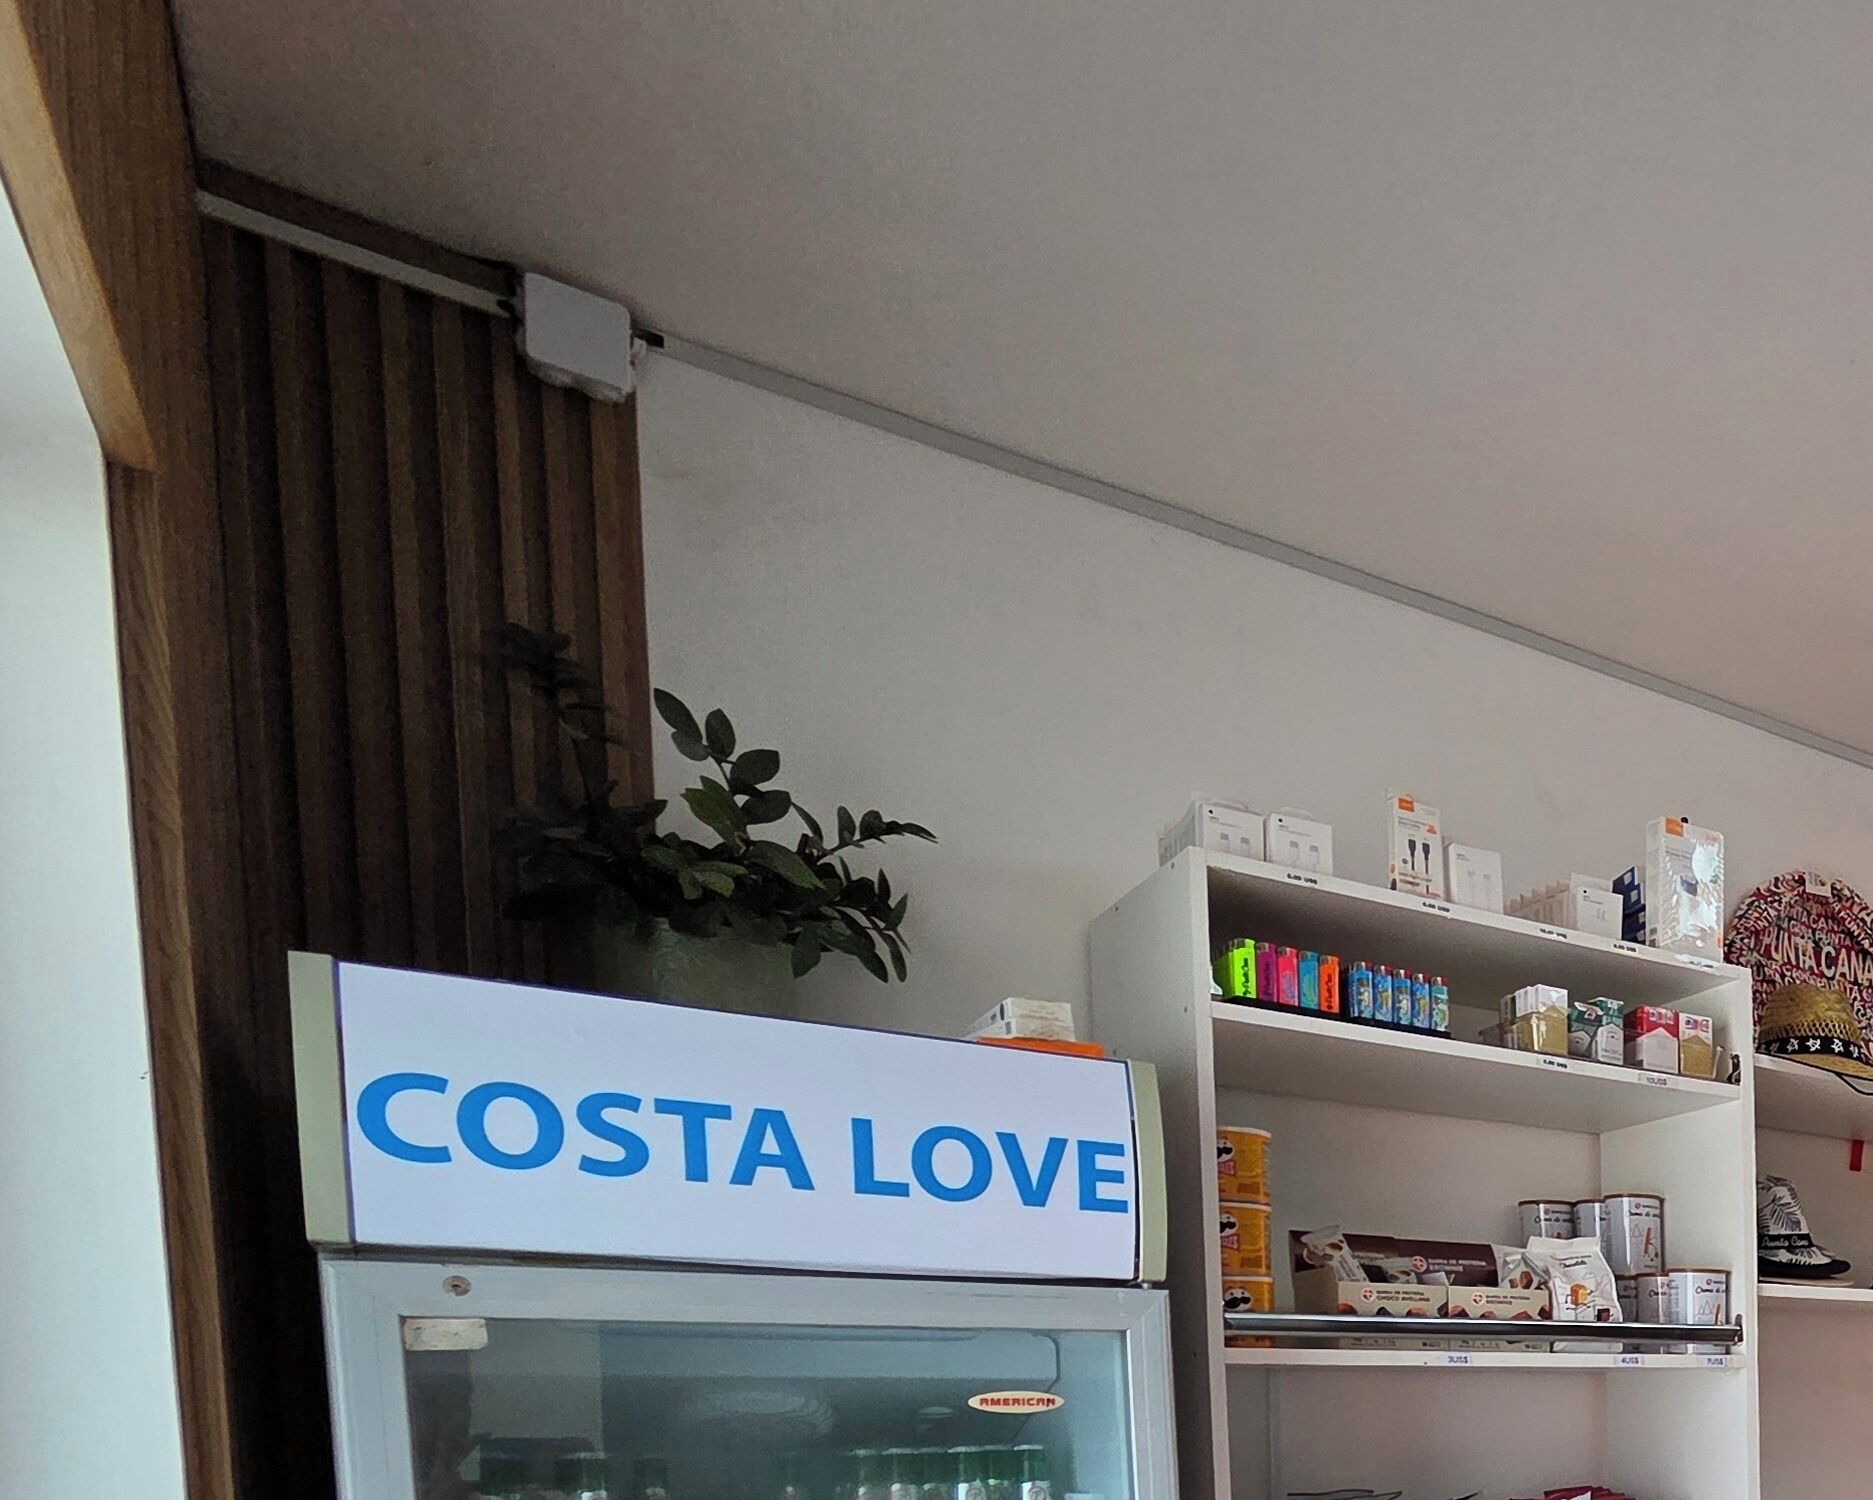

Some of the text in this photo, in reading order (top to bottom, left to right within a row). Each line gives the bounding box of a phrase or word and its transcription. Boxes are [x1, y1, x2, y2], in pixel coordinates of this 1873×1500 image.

[1760, 926, 1817, 971] PUNTA
[356, 1072, 1129, 1214] COSTA LOVE
[979, 1397, 1057, 1407] AMERICAN
